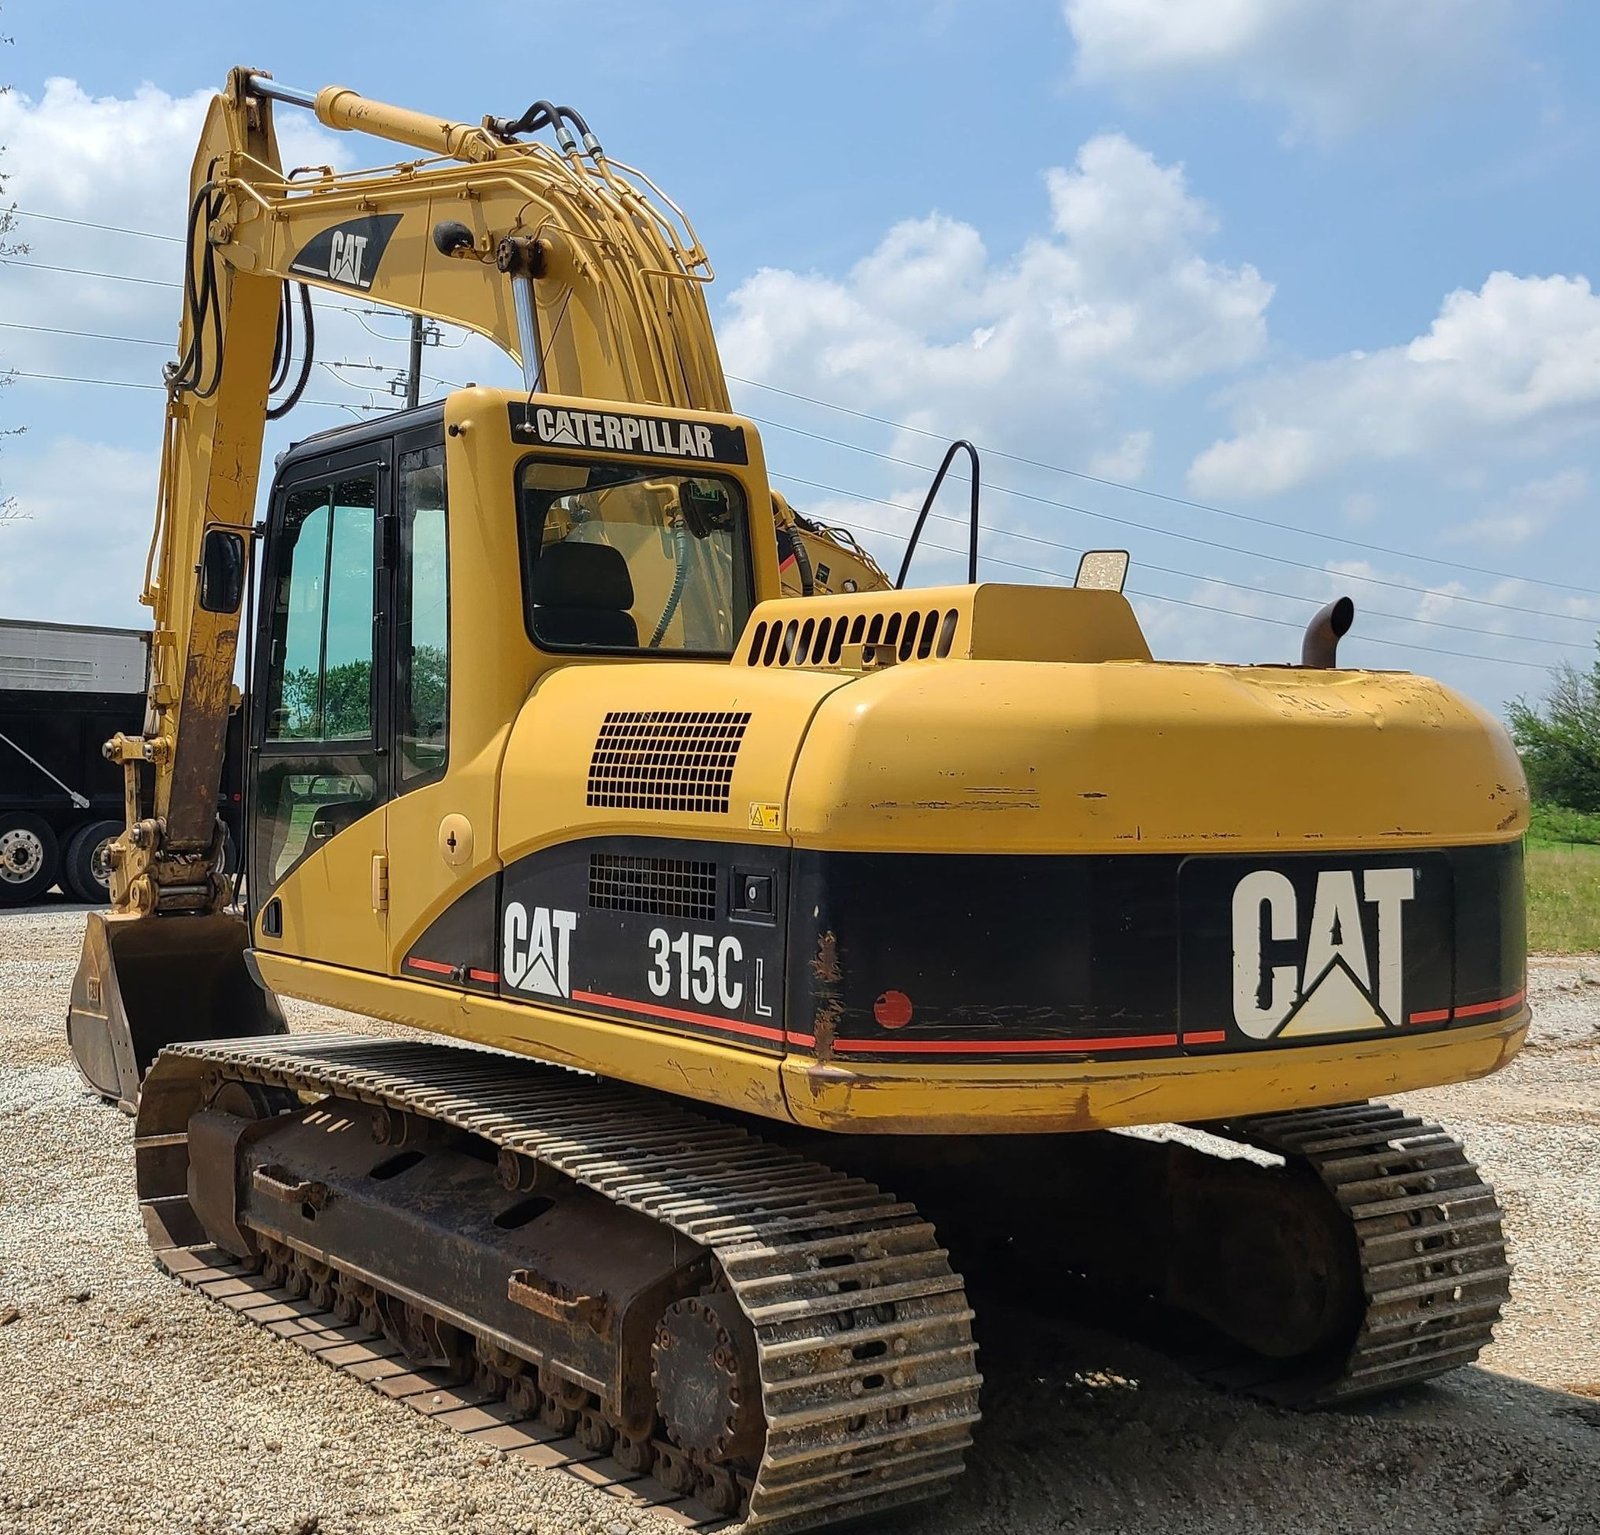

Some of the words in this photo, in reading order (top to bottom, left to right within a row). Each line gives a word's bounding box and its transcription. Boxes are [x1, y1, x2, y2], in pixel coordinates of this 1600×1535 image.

[329, 230, 369, 285] CAT
[536, 408, 715, 459] CATERPILLAR
[503, 901, 577, 999] CAT
[647, 927, 743, 1010] 315C
[754, 957, 772, 1017] L
[1232, 867, 1414, 1040] CAT
